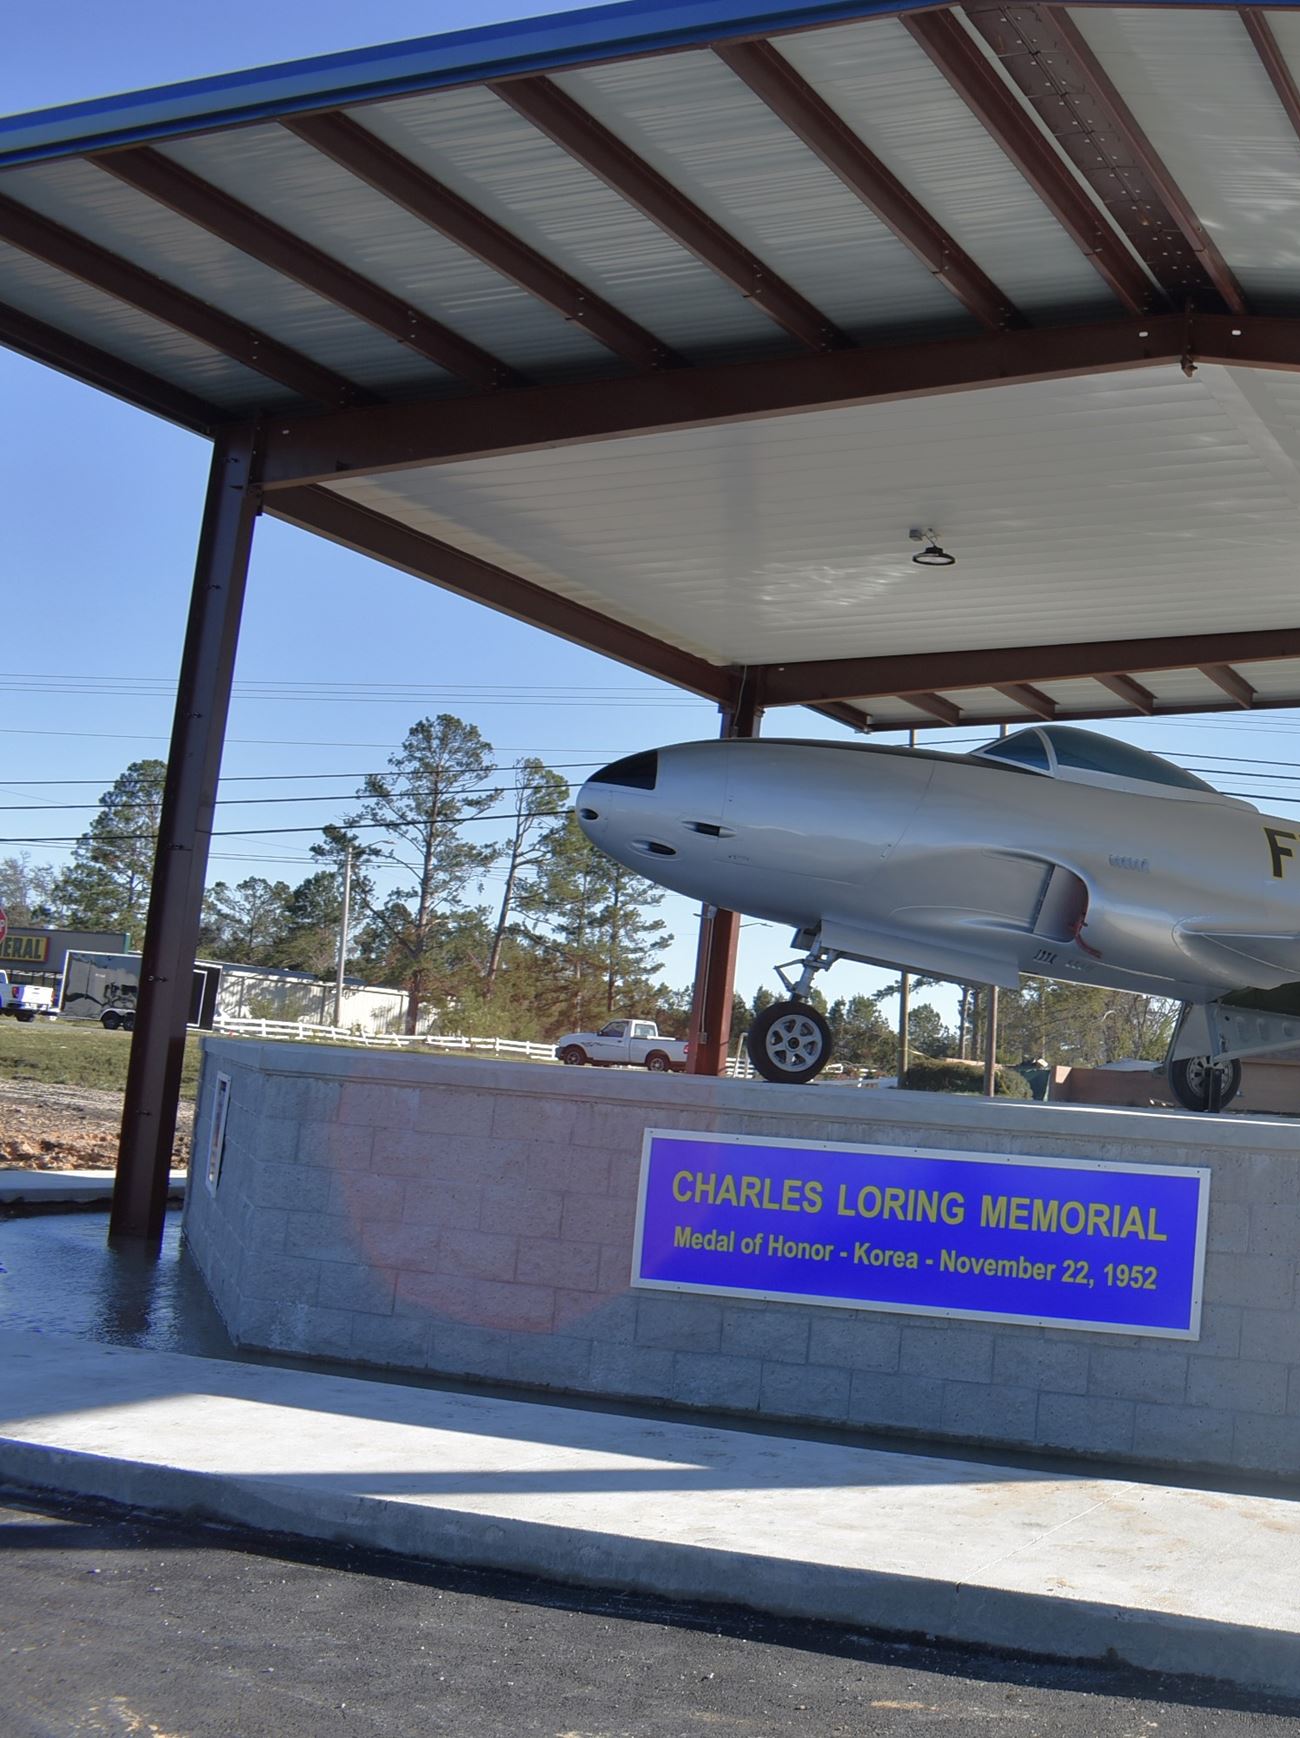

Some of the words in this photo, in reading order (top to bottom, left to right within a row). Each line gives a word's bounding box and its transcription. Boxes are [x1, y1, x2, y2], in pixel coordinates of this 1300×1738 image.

[672, 1170, 824, 1214] CHARLES
[837, 1184, 965, 1225] LORING
[980, 1195, 1168, 1242] MEMORIAL
[673, 1226, 735, 1252] Medal
[740, 1233, 764, 1255] of
[767, 1234, 834, 1261] Honor
[853, 1242, 919, 1270] Korea
[939, 1249, 1056, 1281] November
[1061, 1260, 1095, 1289] 22,
[1103, 1263, 1158, 1290] 1952
